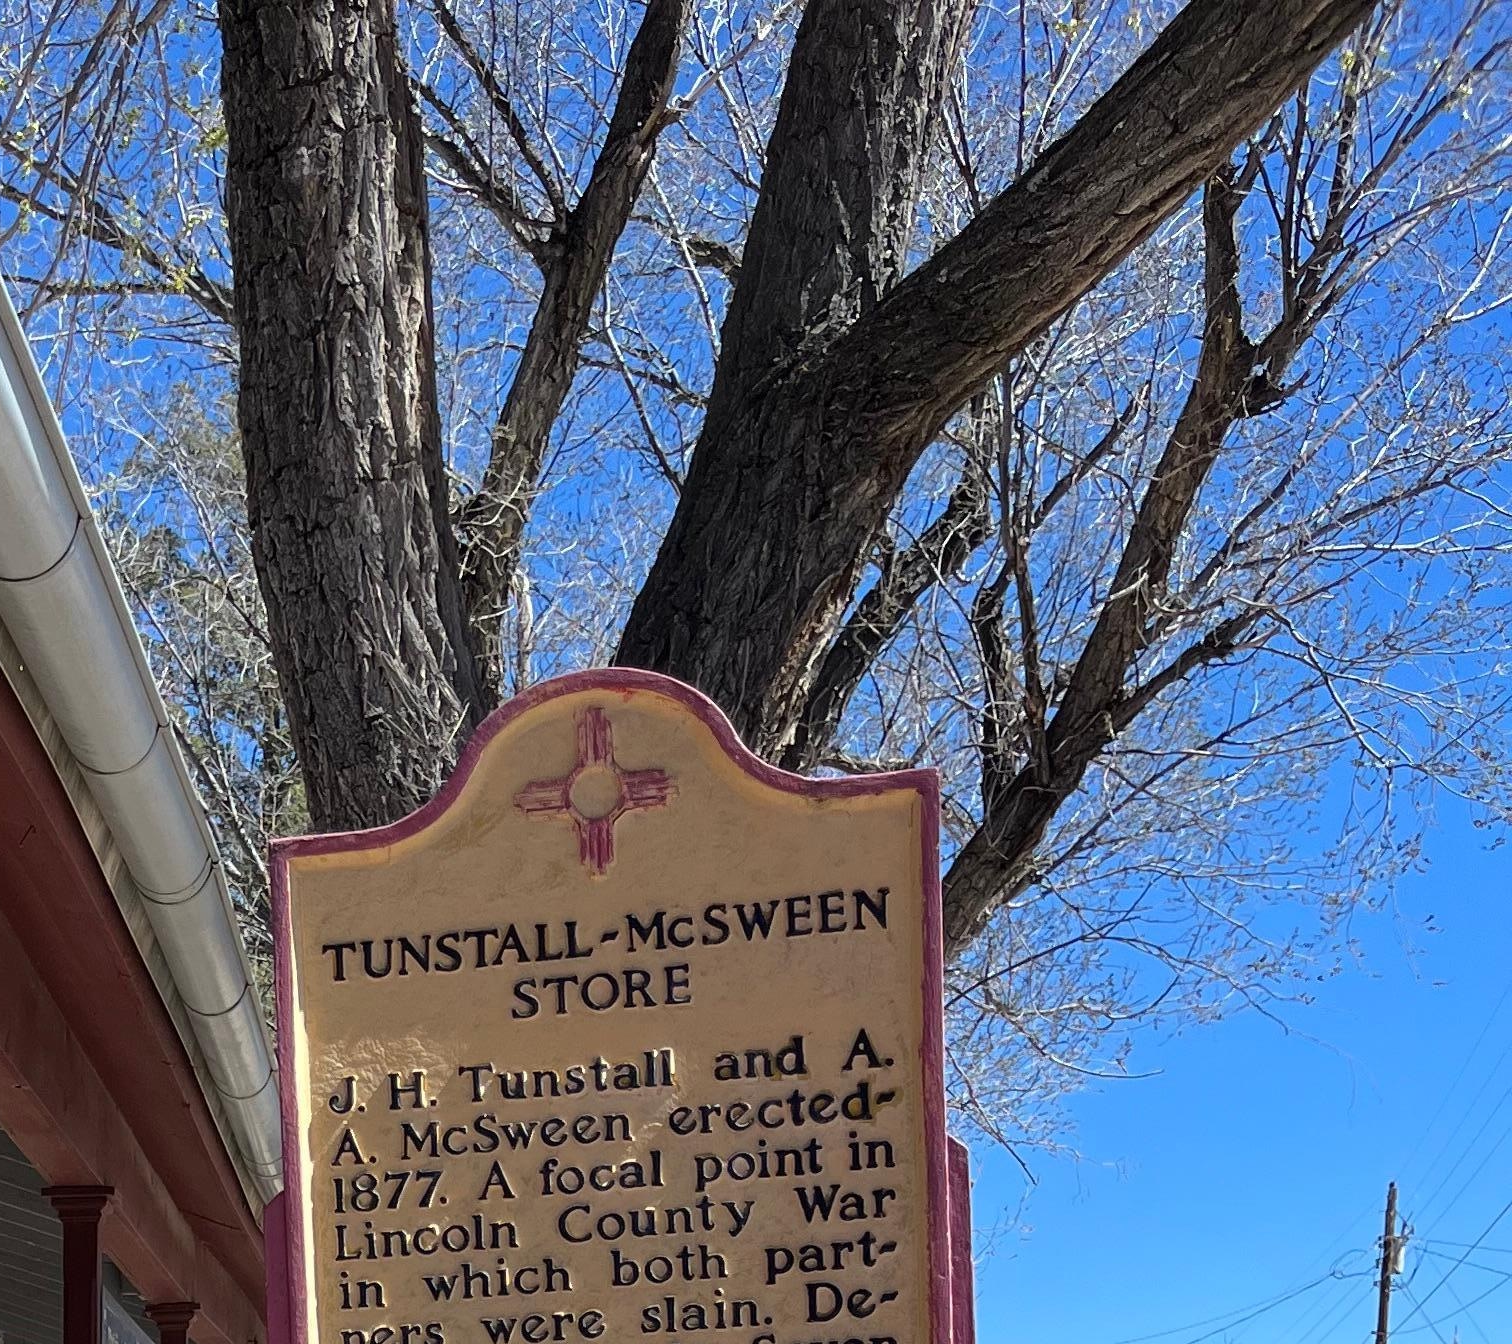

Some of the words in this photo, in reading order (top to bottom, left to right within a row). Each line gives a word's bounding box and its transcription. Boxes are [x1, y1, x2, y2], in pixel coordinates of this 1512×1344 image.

[512, 963, 691, 1018] STORE
[329, 1077, 365, 1114] J.
[388, 1072, 436, 1110] H.
[459, 1050, 673, 1102] Tunstall
[714, 1035, 807, 1080] and
[841, 1028, 894, 1072] A.
[332, 1129, 376, 1166] A.
[401, 1115, 632, 1160] McSween
[333, 1170, 448, 1213] 1877.
[478, 1160, 515, 1200] A
[539, 1150, 663, 1195] focal
[694, 1138, 822, 1192] point
[848, 1131, 895, 1170] in
[336, 1215, 518, 1264] Lincoln
[558, 1196, 755, 1242] County
[793, 1184, 896, 1223] War
[339, 1272, 384, 1309] in
[422, 1258, 572, 1301] which
[610, 1244, 727, 1286] both
[764, 1231, 897, 1285] part-
[480, 1311, 604, 1344] were
[641, 1297, 772, 1333] slain.
[805, 1282, 898, 1322] De-
